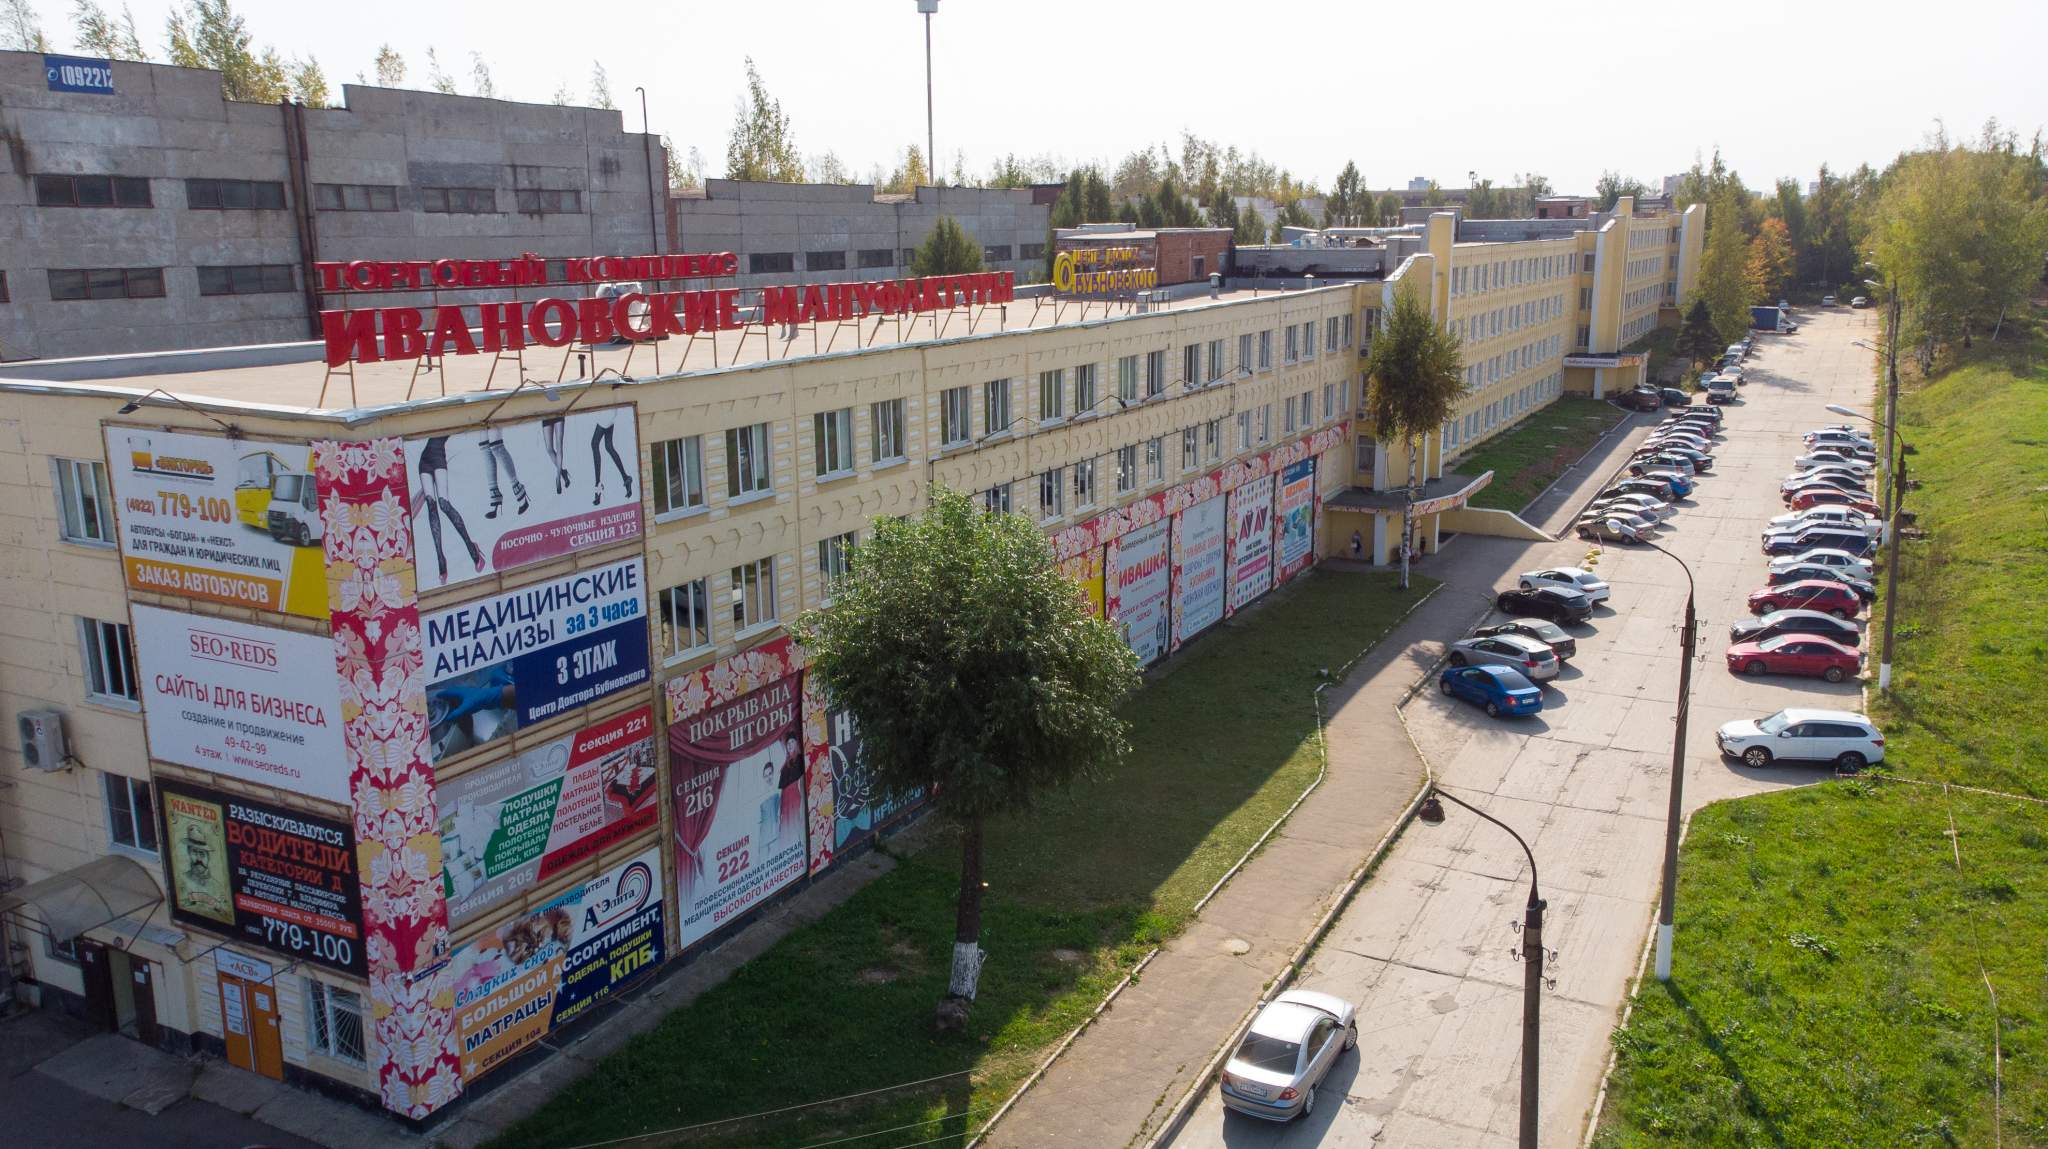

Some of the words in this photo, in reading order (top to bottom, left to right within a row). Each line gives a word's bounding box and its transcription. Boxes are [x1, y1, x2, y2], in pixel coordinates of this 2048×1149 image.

[314, 252, 547, 291] ТОРГОВЫЙ
[320, 287, 744, 368] ИВАНОВСКИЕ
[763, 270, 1015, 327] МАНУФАКТУРЫ
[157, 491, 231, 525] 779-100
[132, 538, 147, 551] ДЛЯ
[149, 541, 187, 557] ГРАЖДАН
[188, 546, 194, 556] И
[195, 547, 260, 568] ЮРИДИЧЕСКИХ
[261, 557, 281, 573] ЛИЦ
[569, 527, 616, 547] СЕКЦИЯ
[136, 563, 181, 589] ЗАКАЗ
[184, 571, 269, 603] АВТОБУСОВ
[1119, 548, 1168, 589] ИВАШКА
[429, 563, 637, 648] МЕДИЦИНСКИЕ
[434, 619, 555, 678] АНАЛИЗЫ
[566, 615, 586, 635] за
[588, 606, 599, 627] 3
[601, 597, 639, 622] часа
[556, 655, 569, 685] 3
[573, 639, 618, 680] ЭТАЖ
[155, 673, 209, 703] САЙТЫ
[214, 686, 247, 710] ДЛЯ
[252, 693, 327, 728] БИЗНЕСА
[529, 701, 557, 721] Центр
[558, 688, 595, 712] Доктора
[595, 668, 646, 702] Бубновского
[689, 683, 792, 744] ПОКРЫВАЛА
[181, 709, 226, 728] создание
[227, 720, 234, 731] и
[236, 723, 305, 746] продвижение
[224, 735, 267, 756] 49-42-99
[579, 727, 624, 753] секция
[626, 715, 648, 735] 221
[729, 702, 794, 751] ШТОРЫ
[233, 756, 301, 779] www.seoreds.ru
[572, 767, 600, 785] ПЛЕДЫ
[676, 766, 720, 796] СЕКЦИЯ
[505, 782, 558, 813] ПОДУШКИ
[556, 792, 601, 818] ПОЛОТЕНЦА
[562, 780, 600, 801] МАТРАЦЫ
[685, 786, 714, 818] 216
[229, 803, 344, 847] РАЗЫСКИВАЮТСЯ
[503, 796, 556, 826] МАТРАЦЫ
[507, 811, 550, 837] ОДЕЯЛА
[553, 805, 602, 833] ПОСТЕЛЬНОЕ
[579, 817, 603, 834] БЕЛЬЕ
[226, 820, 351, 873] ВОДИТЕЛИ
[494, 833, 547, 862] ПОКРЫВАЛА
[498, 822, 550, 850] ПОЛОТЕНЦА
[716, 834, 750, 861] СЕКЦИЯ
[239, 850, 324, 890] КАТЕГОРИИ
[488, 855, 522, 875] ПЛЕДЫ,
[523, 846, 541, 860] КПБ
[508, 868, 533, 890] 205
[718, 850, 750, 884] 222
[543, 876, 610, 915] ПРОИЗВОДИТЕЛЯ
[684, 891, 736, 927] МЕДИЦИНСКАЯ
[737, 876, 764, 900] ОДЕЖДА
[771, 850, 804, 878] УНИФОРМА
[694, 862, 765, 910] ПРОФЕССИОНАЛЬНАЯ
[713, 885, 761, 923] ВЫСОКОГО
[763, 860, 805, 893] КАЧЕСТВА
[262, 915, 352, 965] 779-100
[567, 958, 607, 985] ОДЕЯЛА,
[609, 929, 652, 959] ПОДУШКИ
[455, 966, 518, 1009] Сладких
[524, 943, 554, 971] снов
[610, 943, 652, 985] КПБ
[462, 968, 548, 1030] БОЛЬШОЙ
[556, 995, 592, 1024] СЕКЦИЯ
[465, 991, 553, 1052] МАТРАЦЫ
[482, 1038, 522, 1068] СЕКЦИЯ
